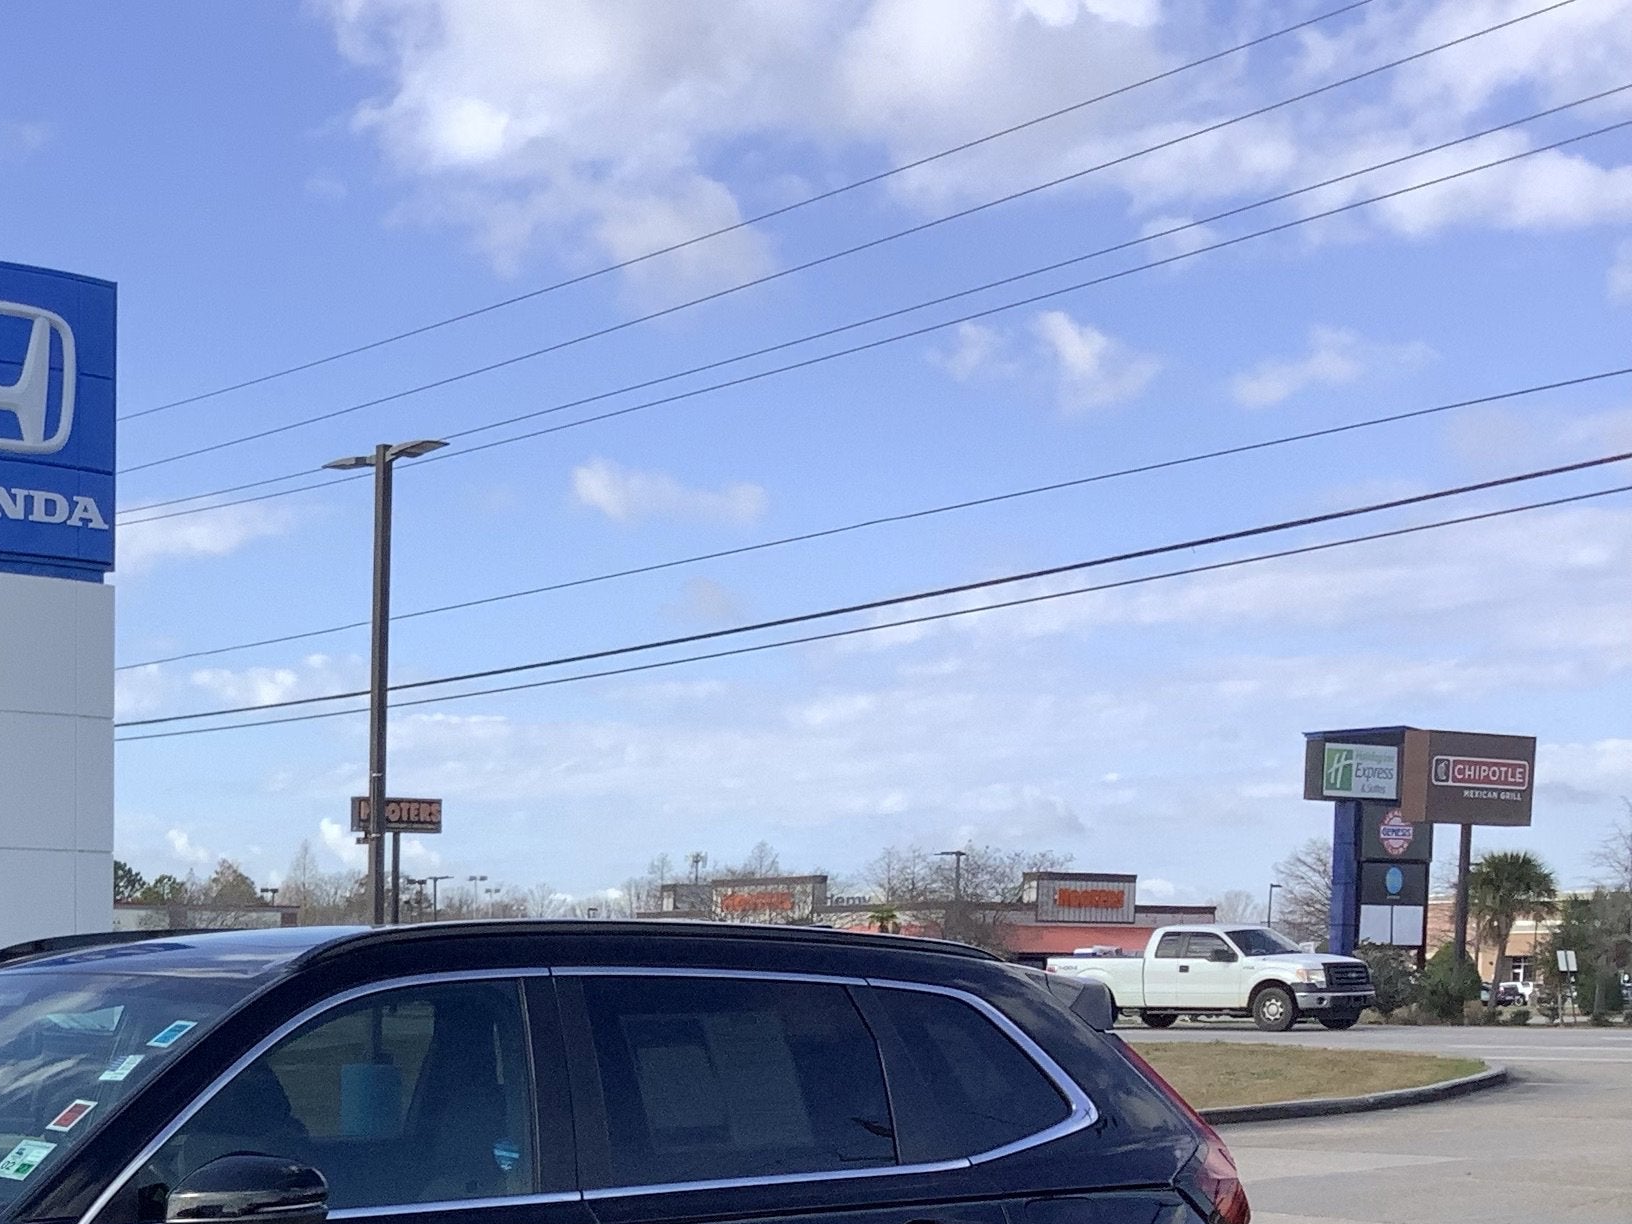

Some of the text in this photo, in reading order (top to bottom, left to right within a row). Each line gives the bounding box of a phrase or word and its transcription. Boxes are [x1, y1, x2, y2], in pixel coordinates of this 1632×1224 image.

[1355, 762, 1394, 782] Express
[1454, 764, 1524, 783] CHIPOTLE
[1463, 789, 1522, 801] MEXICAN GRILL
[360, 800, 441, 822] HOTERS
